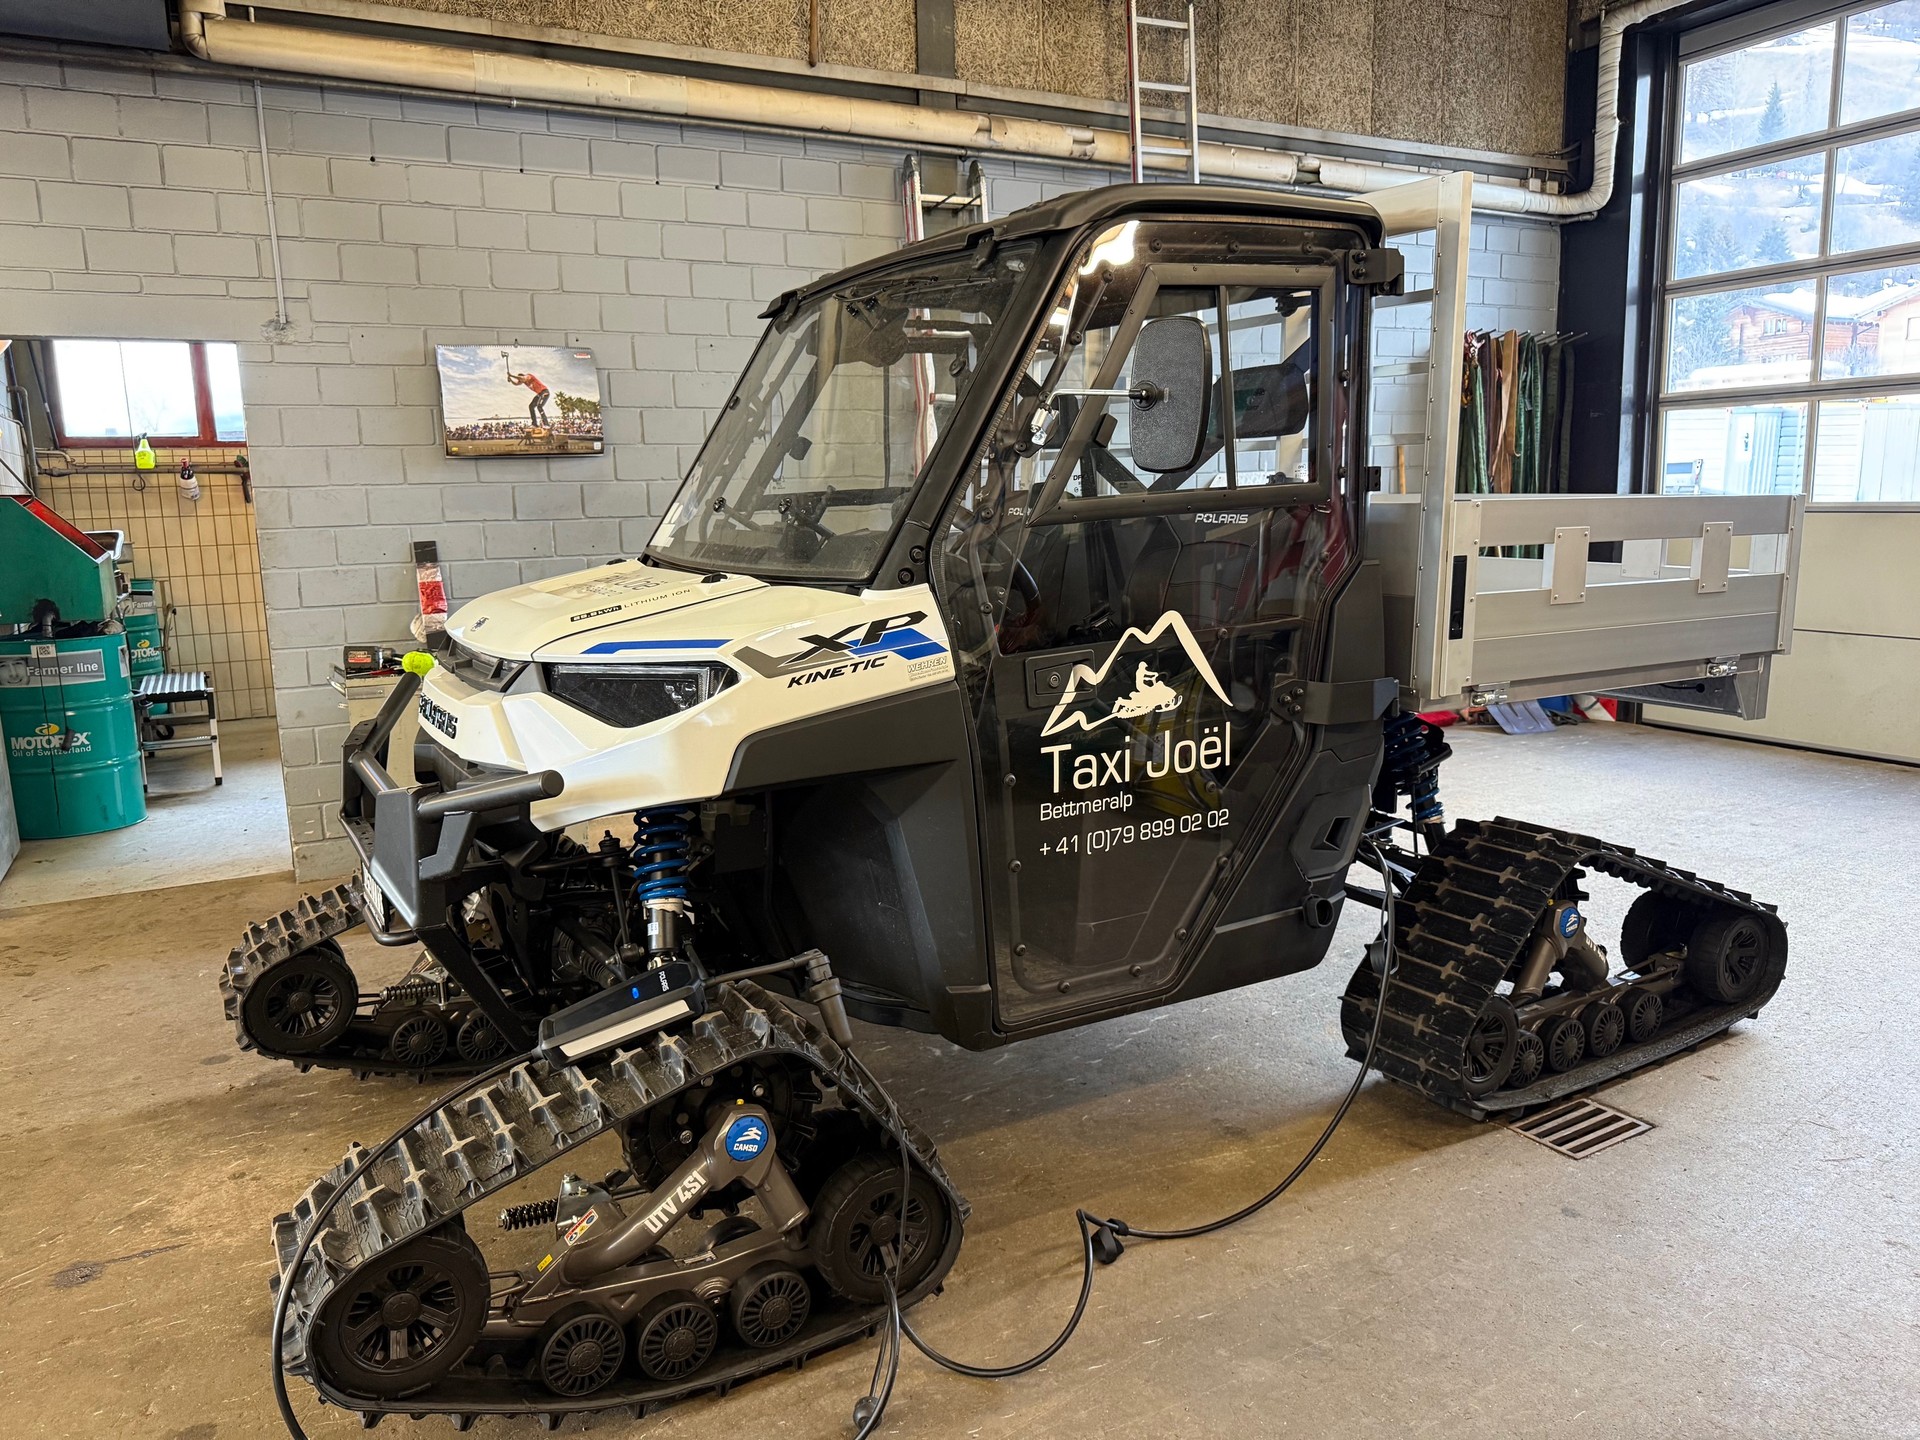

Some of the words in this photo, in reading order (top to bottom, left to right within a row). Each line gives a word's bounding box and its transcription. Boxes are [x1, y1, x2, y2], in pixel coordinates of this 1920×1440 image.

[1195, 513, 1248, 524] POLARIS
[624, 595, 668, 608] LITHIUM
[672, 588, 691, 597] ION
[783, 610, 929, 668] XP
[26, 664, 74, 676] Farmer
[77, 662, 99, 673] line
[787, 655, 888, 688] KINETIC
[907, 656, 948, 673] WEHREN
[12, 749, 23, 758] Oil
[26, 748, 34, 757] of
[1040, 735, 1131, 794] Taxi
[1146, 721, 1231, 778] Joël
[1040, 791, 1133, 822] Bettmeralp
[1056, 834, 1079, 855] 41
[1086, 825, 1135, 855] (0)79
[1140, 818, 1175, 841] 899
[1180, 813, 1202, 834] 02
[1207, 808, 1229, 829] 02
[733, 1142, 759, 1153] CAMSO
[644, 1197, 678, 1234] UTV
[676, 1170, 707, 1203] 4S1
